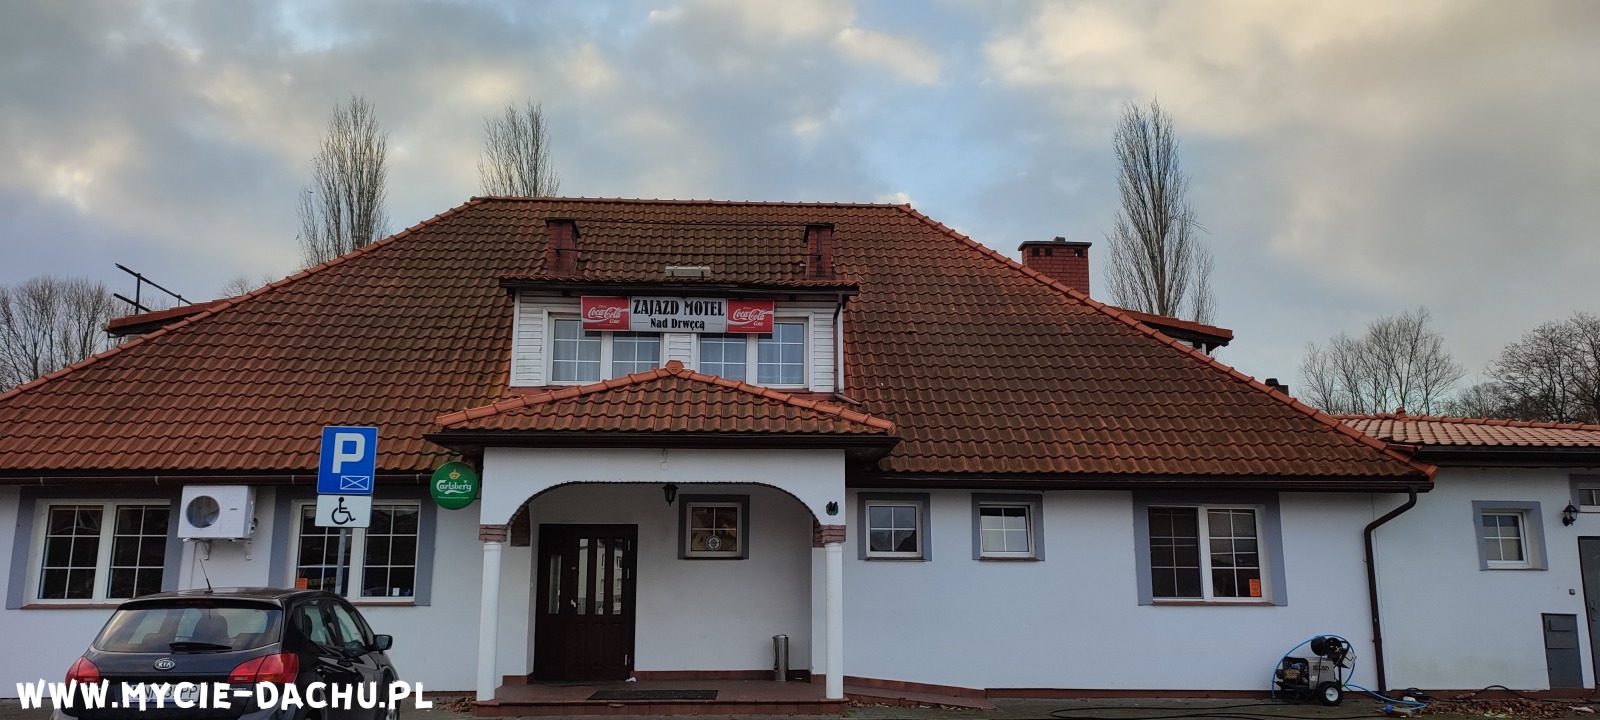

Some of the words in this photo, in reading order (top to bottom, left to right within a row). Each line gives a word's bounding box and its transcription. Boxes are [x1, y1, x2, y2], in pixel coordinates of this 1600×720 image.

[633, 299, 679, 316] ZAJAZD
[683, 300, 725, 316] MOTEL
[650, 318, 668, 328] Nad
[671, 318, 705, 331] Drwęcą
[332, 432, 366, 474] P
[436, 479, 472, 493] Carlsberg
